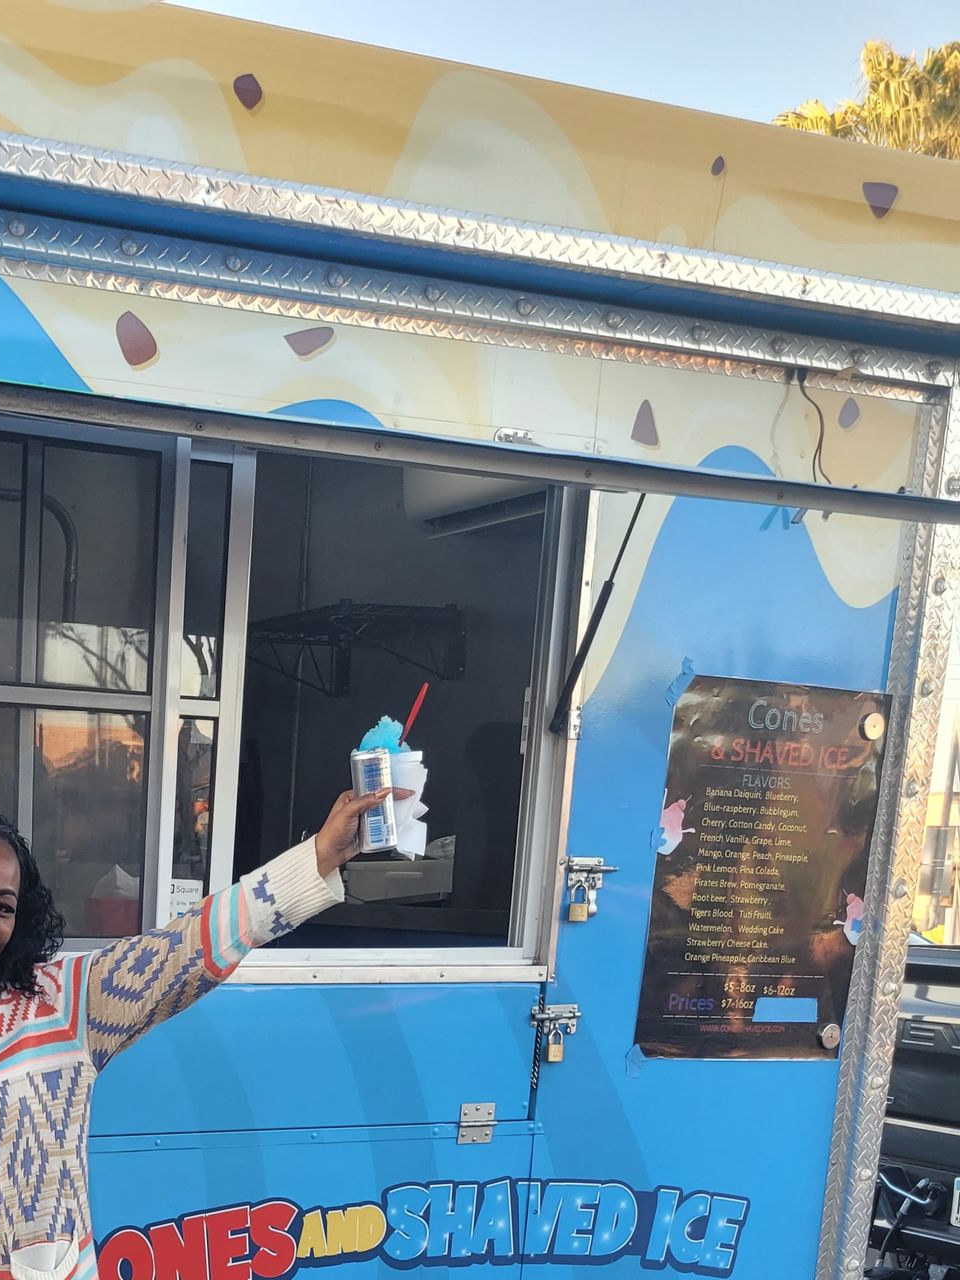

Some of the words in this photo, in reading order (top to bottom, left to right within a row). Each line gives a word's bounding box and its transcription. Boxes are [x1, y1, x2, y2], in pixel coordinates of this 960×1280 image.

[747, 699, 824, 734] Cones
[711, 743, 725, 760] &
[730, 737, 815, 767] SHAVED
[818, 745, 849, 770] ICE
[742, 774, 792, 789] FLAVORS:
[705, 786, 732, 797] Banana
[765, 791, 799, 803] Blueberry,
[760, 806, 799, 818] Bubblegum,
[701, 817, 727, 829] Cherry,
[728, 819, 752, 829] Cotton
[754, 821, 776, 833] Candy,
[700, 832, 724, 843] French
[697, 848, 723, 859] Mango,
[725, 850, 750, 861] Orange,
[752, 851, 774, 861] Peach,
[775, 852, 808, 864] Pineapple,
[696, 863, 711, 872] Pink
[713, 863, 738, 874] Lemon,
[755, 866, 780, 876] Colada,
[176, 885, 199, 894] Square
[694, 877, 719, 888] Pirates
[720, 879, 738, 889] Brew,
[692, 892, 710, 902] Root
[690, 907, 711, 919] Tigers
[712, 909, 734, 919] Blood,
[688, 922, 733, 933] Watermelon,
[737, 924, 768, 936] Wedding
[768, 925, 784, 935] Cake
[686, 937, 725, 949] Strawberry
[727, 939, 750, 948] Cheese
[685, 952, 711, 963] Orange
[747, 954, 780, 964] Caribbean
[781, 955, 796, 964] Blue
[668, 992, 715, 1012] Prices
[297, 1204, 386, 1258] AND
[382, 1179, 638, 1261] SHAVED
[644, 1188, 748, 1269] ICE
